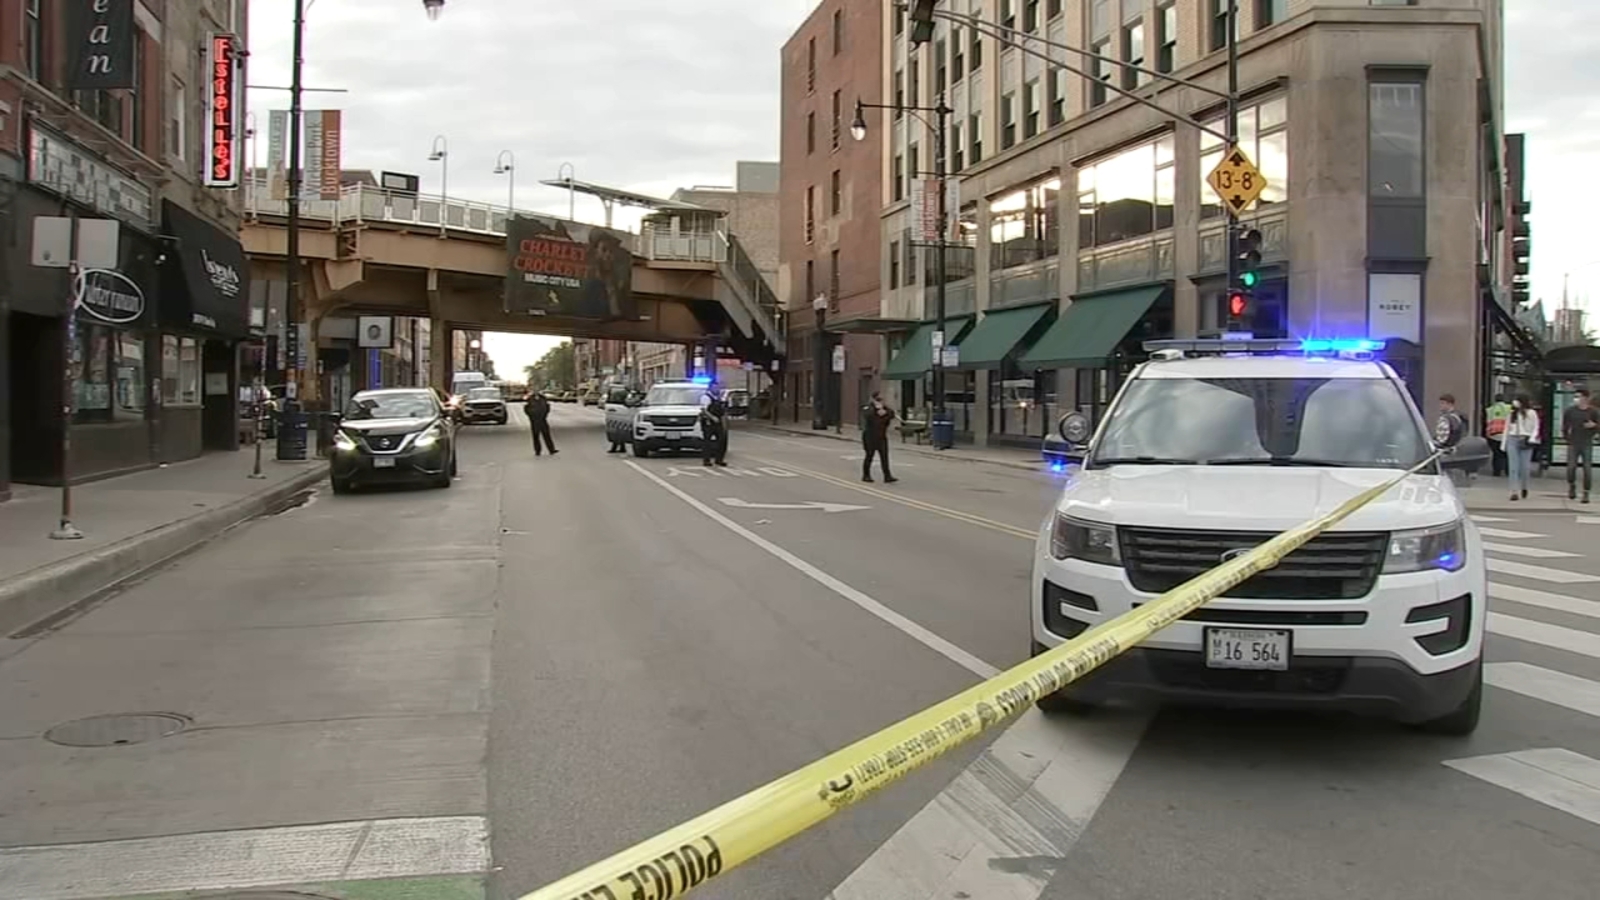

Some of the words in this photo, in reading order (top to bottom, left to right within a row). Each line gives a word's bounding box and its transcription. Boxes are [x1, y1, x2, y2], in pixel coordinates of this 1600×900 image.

[306, 120, 321, 149] Park
[321, 130, 338, 194] Bucktown
[520, 239, 585, 261] CHARLEY
[1224, 641, 1242, 661] 16
[1252, 642, 1280, 662] 564
[617, 834, 724, 900] POLICE
